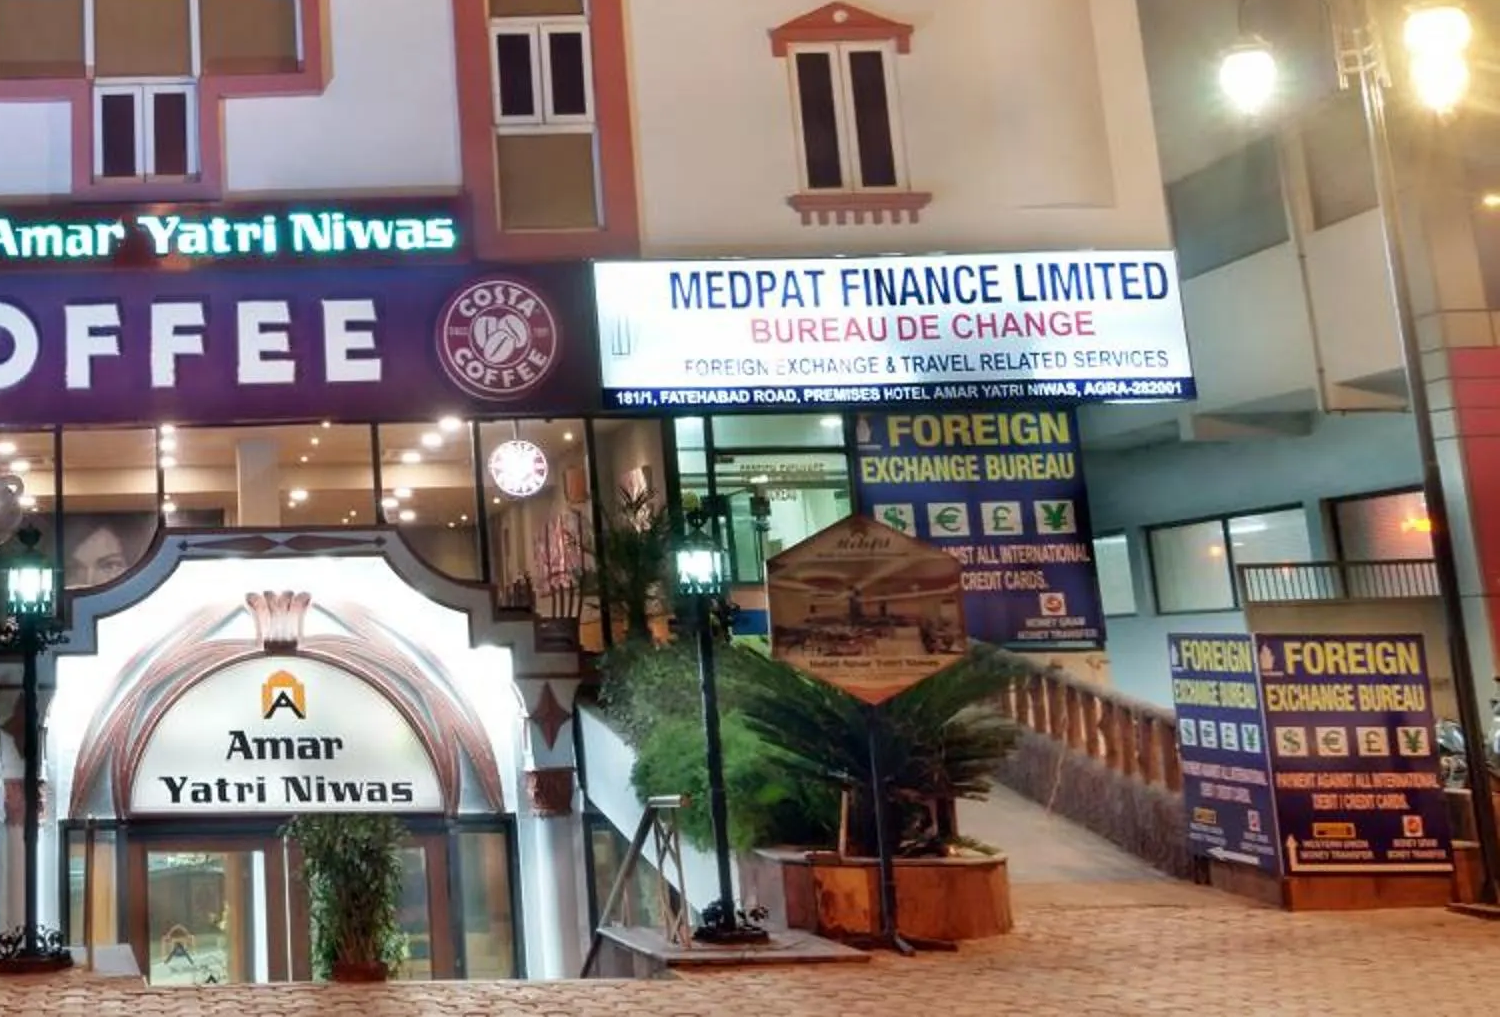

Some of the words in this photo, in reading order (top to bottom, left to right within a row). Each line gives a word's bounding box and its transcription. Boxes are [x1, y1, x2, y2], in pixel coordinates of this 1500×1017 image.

[137, 214, 277, 254] Yatri
[291, 211, 455, 250] Niwas
[458, 285, 538, 318] COSTA
[669, 270, 825, 310] MEDPAT
[840, 264, 1003, 307] FINANCE
[1014, 261, 1169, 303] LIMITED
[751, 316, 887, 344] BUREAU
[897, 314, 941, 341] DE
[952, 310, 1096, 339] CHANGE
[454, 347, 548, 388] COFFEE
[684, 358, 769, 377] FOREIGN
[776, 356, 880, 376] EXCHANGE
[885, 356, 897, 374] &
[902, 353, 975, 374] TRAVEL
[980, 351, 1068, 371] RELATED
[1073, 349, 1169, 369] SERVICES
[659, 389, 751, 405] FATEHABAD
[753, 388, 801, 404] ROAD,
[803, 386, 881, 402] PREMISES
[884, 386, 931, 401] HOTEL
[933, 385, 979, 400] AMAR
[981, 384, 1025, 398] YATRI
[1027, 383, 1081, 398] NIWAS,
[887, 412, 1072, 447] FOREIGN
[861, 454, 980, 483] EXCHANGE
[985, 452, 1076, 481] BUREAU
[1001, 543, 1091, 564] INTERNATIONAL
[1180, 639, 1253, 672] FOREIGN
[1283, 641, 1421, 675] FOREIGN
[1266, 684, 1355, 712] EXCHANGE
[1359, 684, 1426, 712] BUREAU
[226, 731, 343, 761] Amar
[159, 776, 267, 803] Yatri
[279, 776, 414, 803] Niwas
